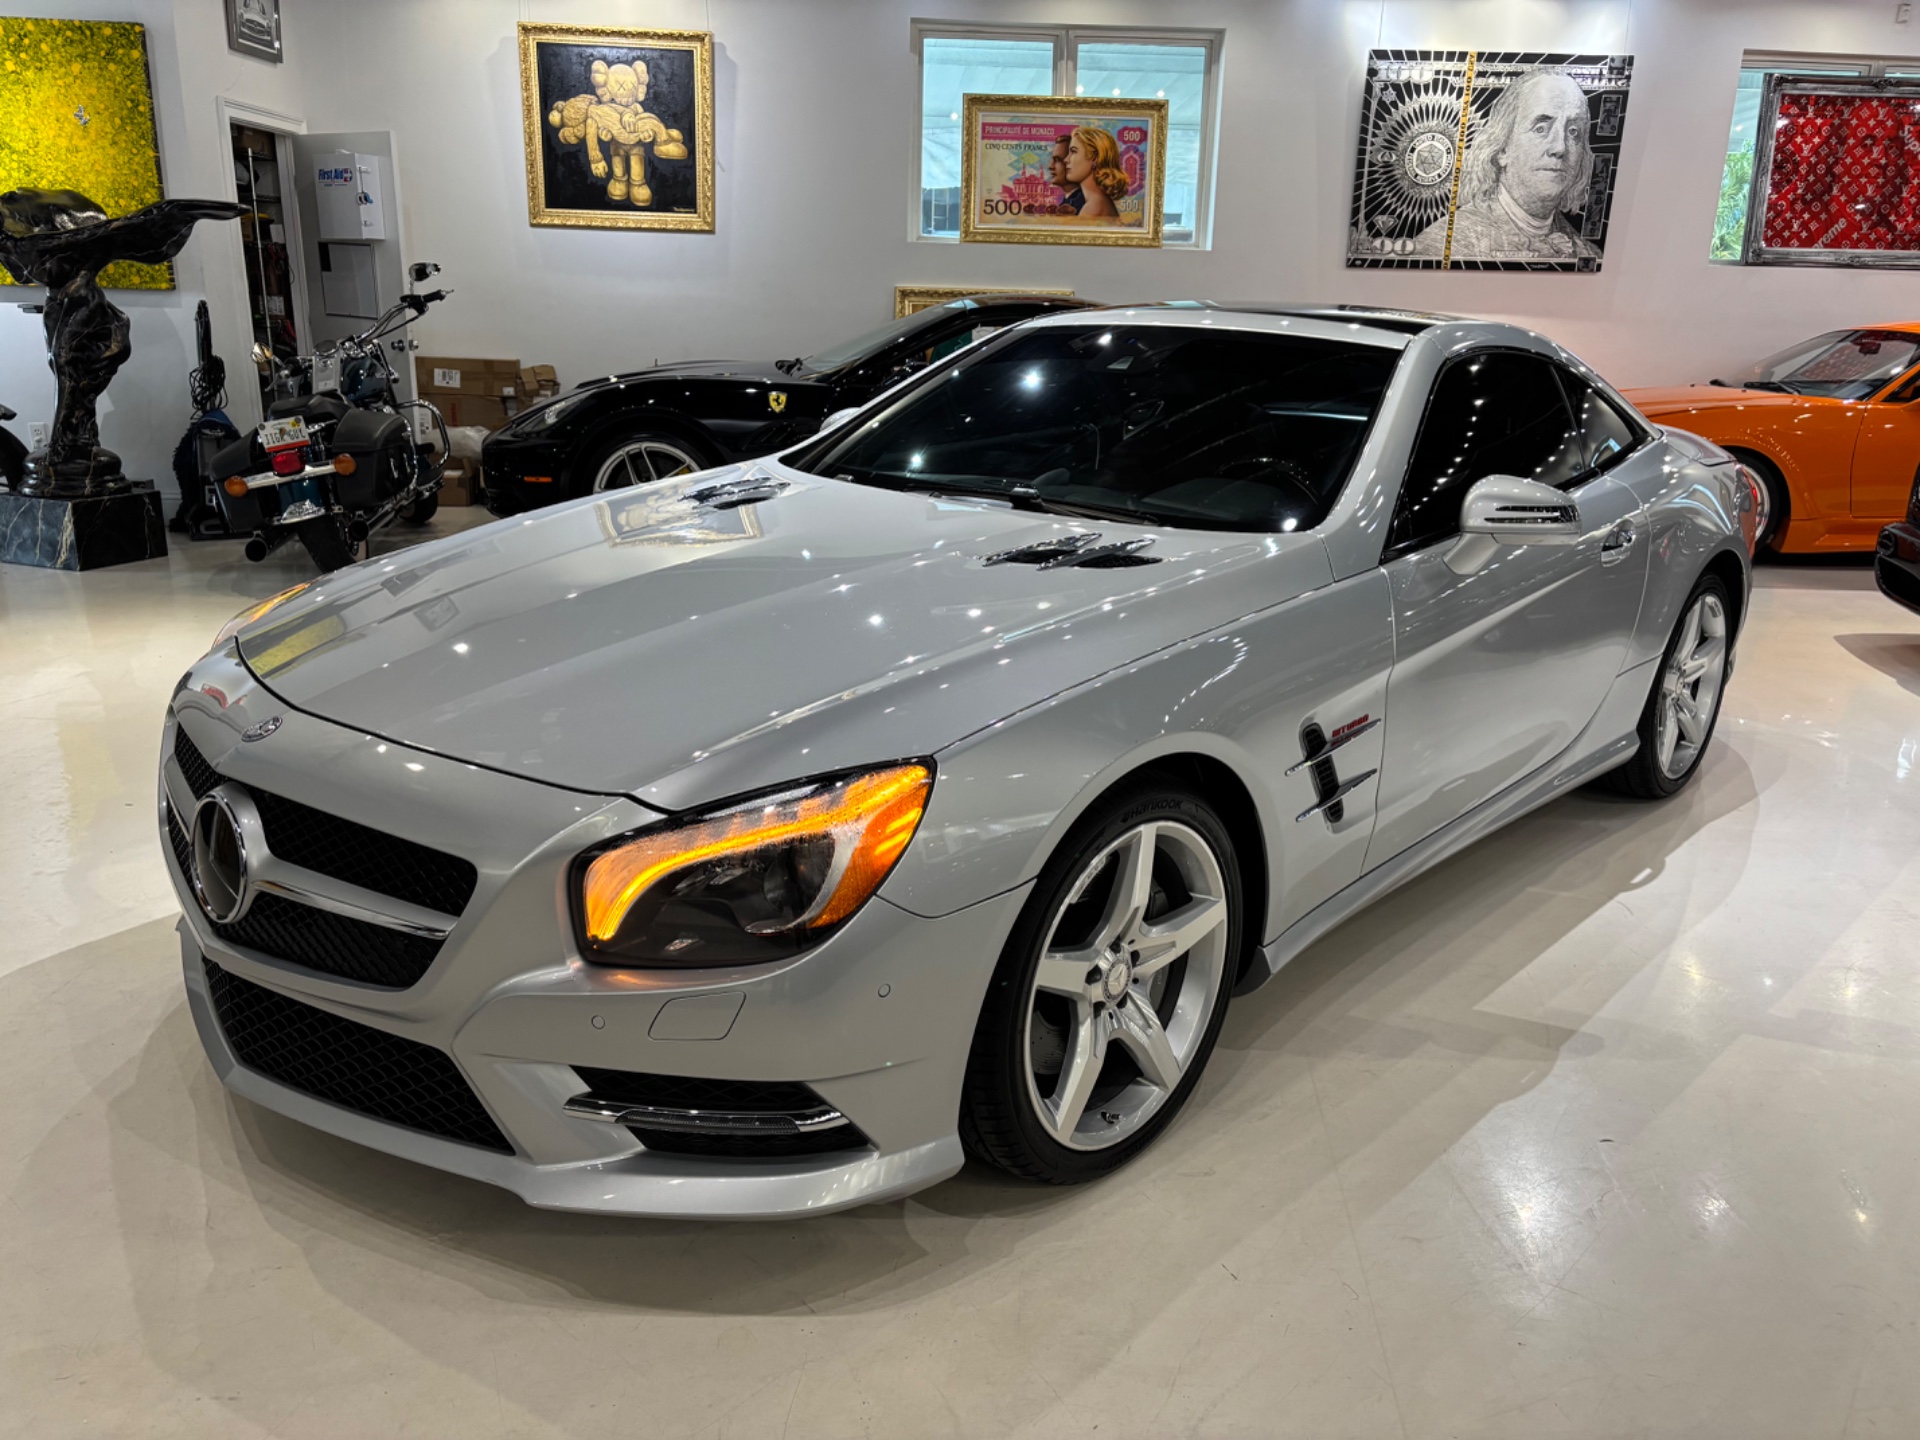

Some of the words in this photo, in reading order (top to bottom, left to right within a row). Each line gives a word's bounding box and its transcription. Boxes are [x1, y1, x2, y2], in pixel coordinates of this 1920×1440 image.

[1022, 127, 1030, 135] DE
[1031, 127, 1055, 136] MONACO
[1123, 130, 1141, 142] 500
[984, 143, 1000, 151] CINQ
[1001, 143, 1023, 151] CENTS
[1023, 143, 1048, 151] FRANCS
[318, 168, 333, 181] First
[334, 168, 344, 181] Aid
[983, 199, 1022, 216] 500
